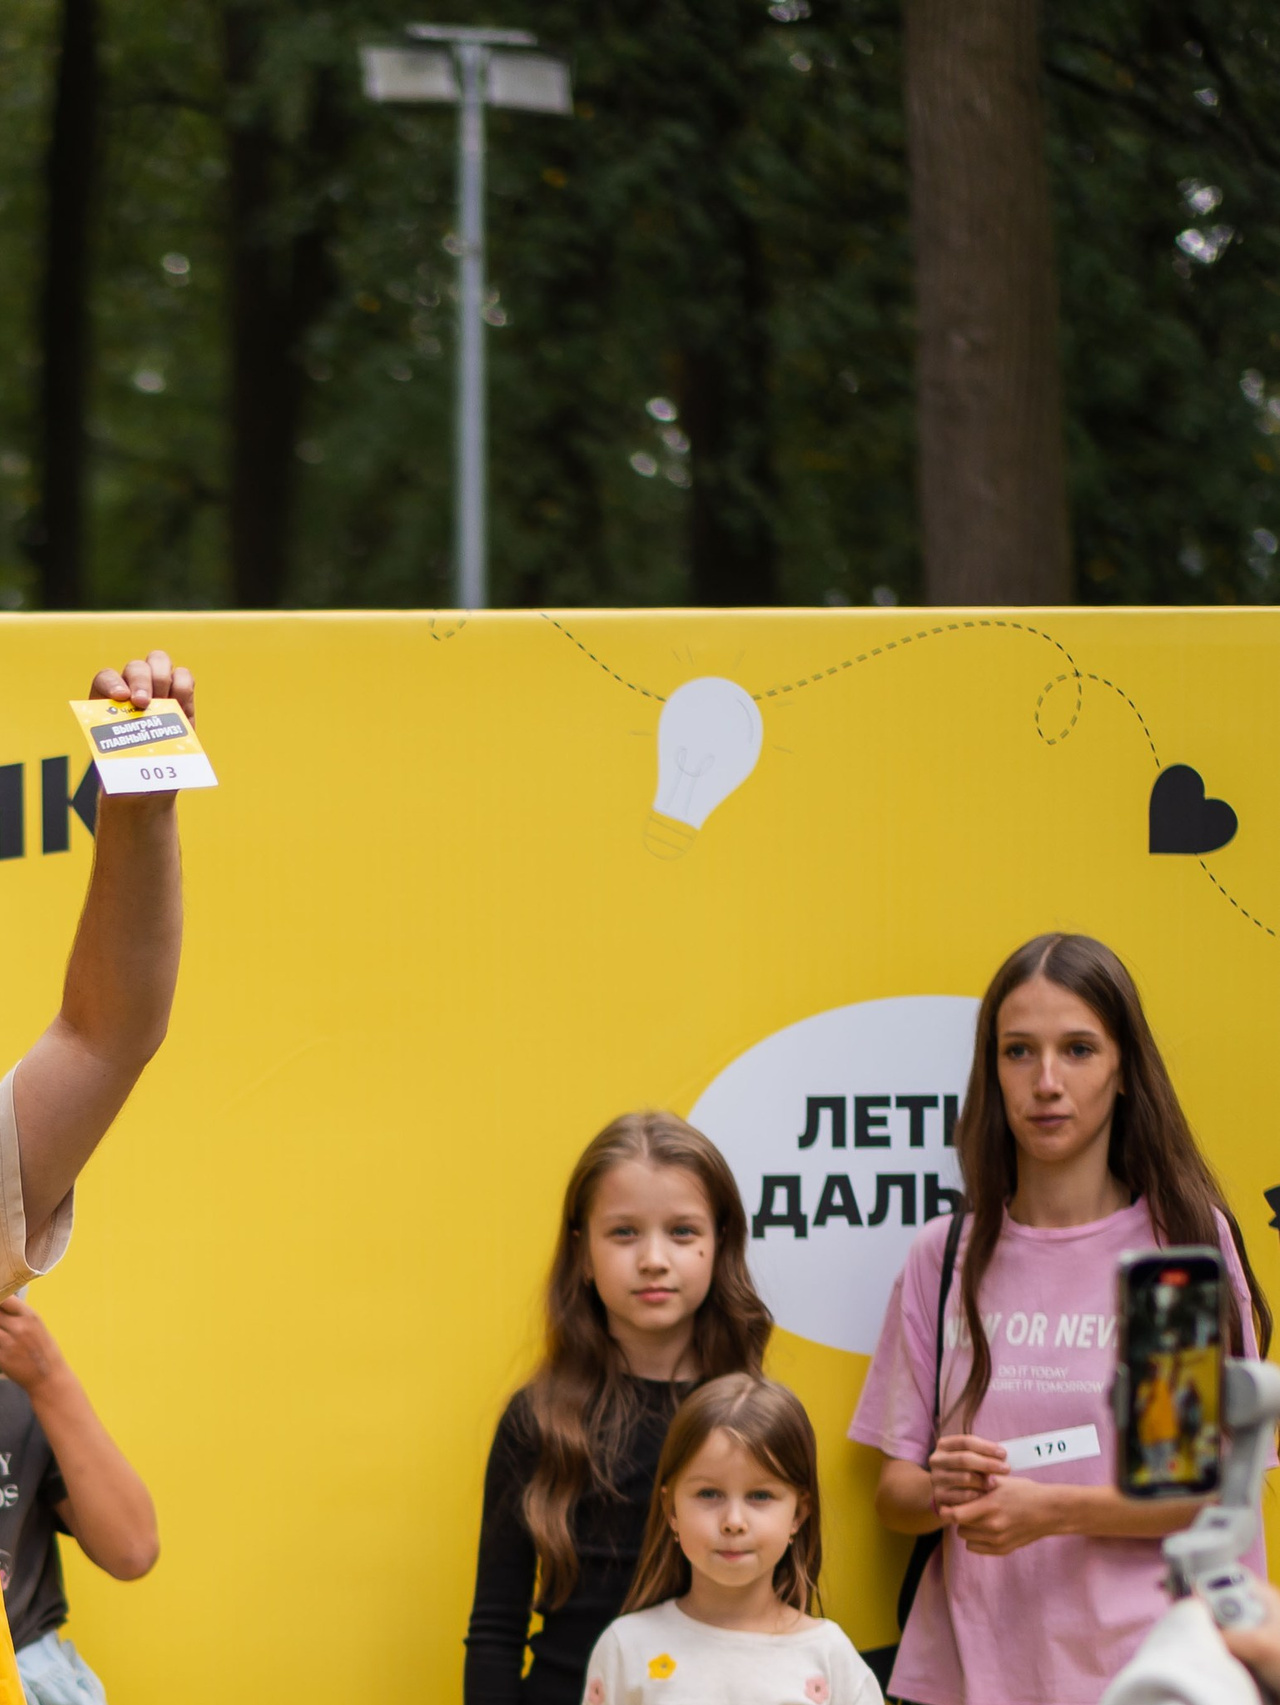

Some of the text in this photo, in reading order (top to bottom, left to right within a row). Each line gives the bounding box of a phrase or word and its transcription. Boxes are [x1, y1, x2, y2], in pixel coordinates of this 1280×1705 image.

[112, 715, 163, 736] ВЫИГРАЙ
[99, 724, 183, 750] ГЛАВНЫЙ ПРИЗ!
[140, 766, 177, 781] 003
[1005, 1310, 1049, 1348] OR
[1054, 1312, 1119, 1350] NEV
[1030, 1366, 1068, 1379] TODAY
[1036, 1379, 1105, 1395] TOMORROW
[1034, 1440, 1066, 1457] 170
